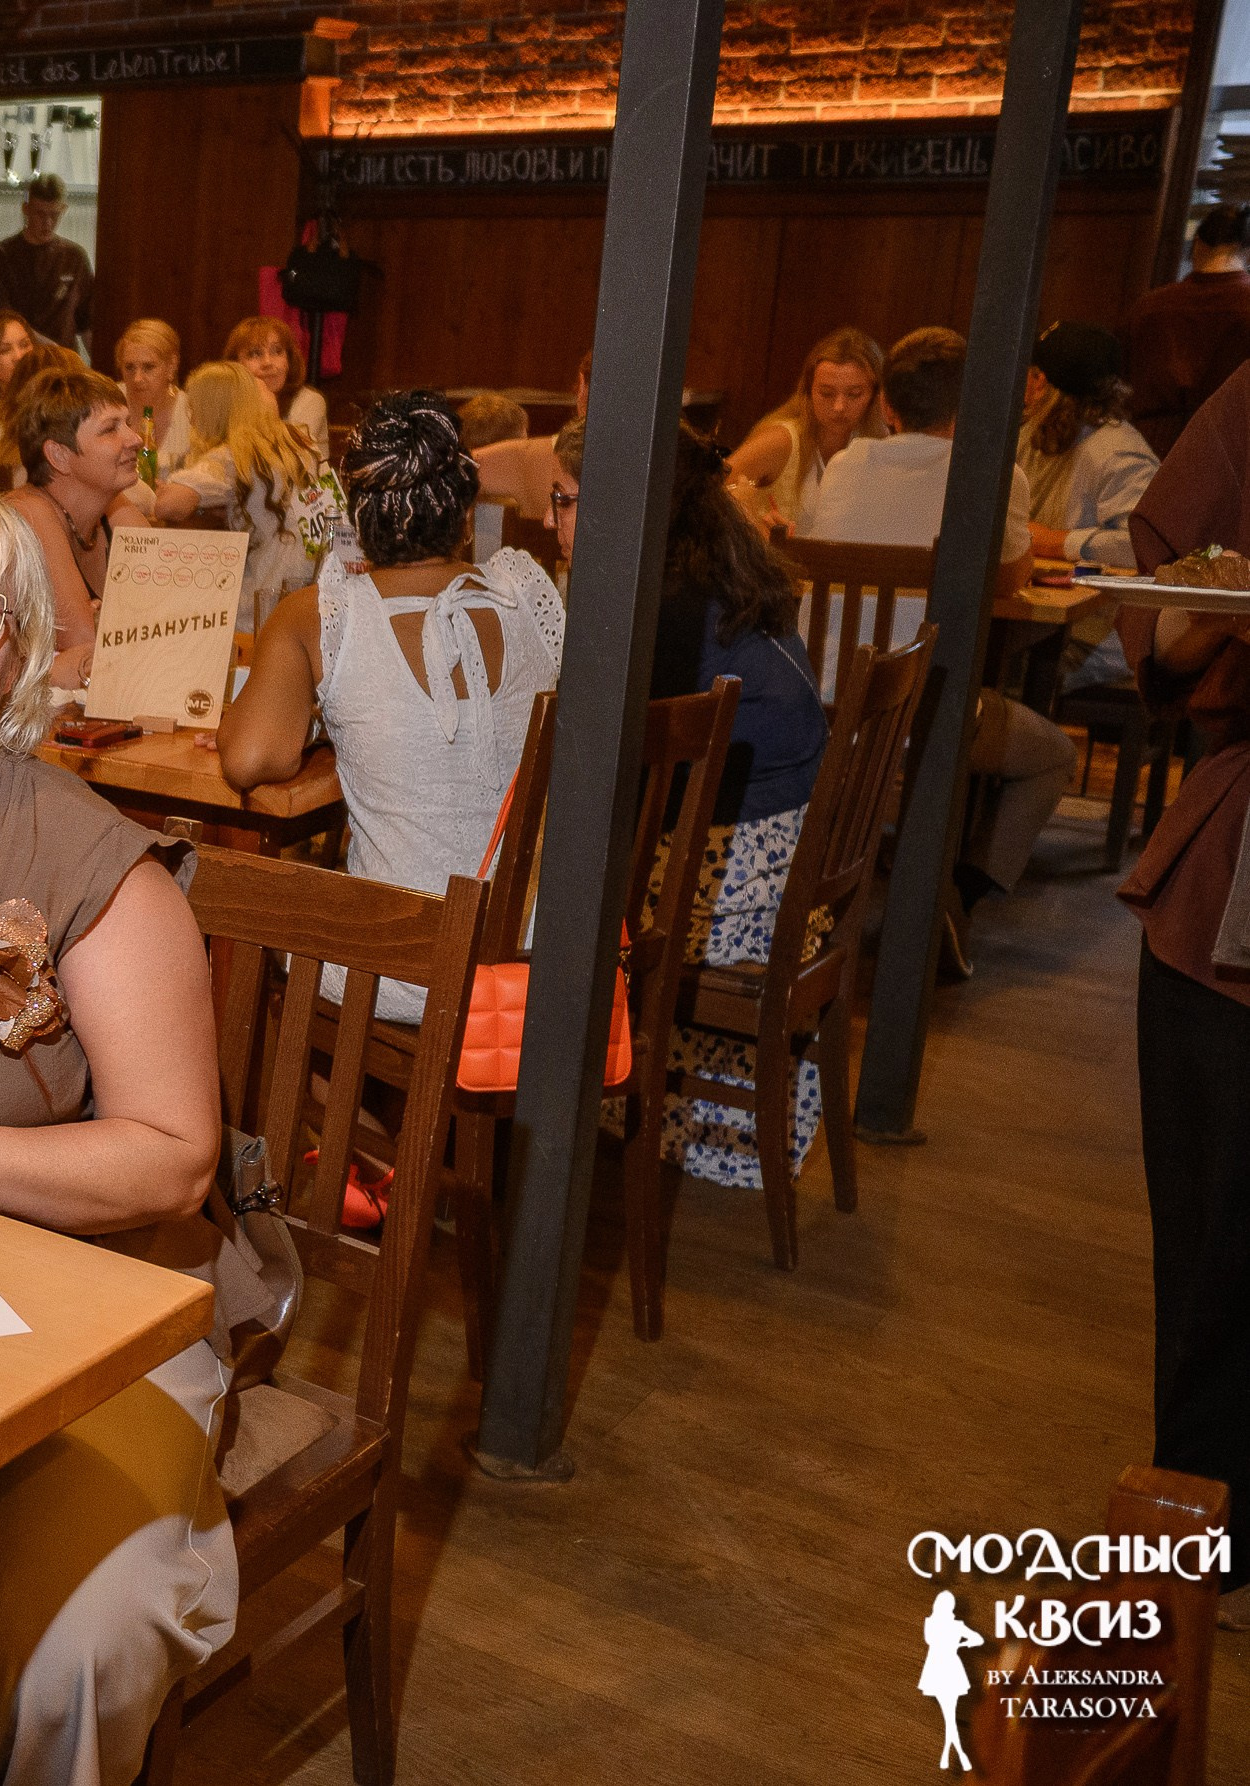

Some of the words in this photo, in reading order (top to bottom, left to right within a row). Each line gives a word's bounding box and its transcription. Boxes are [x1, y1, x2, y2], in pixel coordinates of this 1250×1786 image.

[41, 56, 80, 83] das
[798, 141, 841, 179] ТЫ
[102, 610, 229, 648] КВИЗАНУТЫЕ
